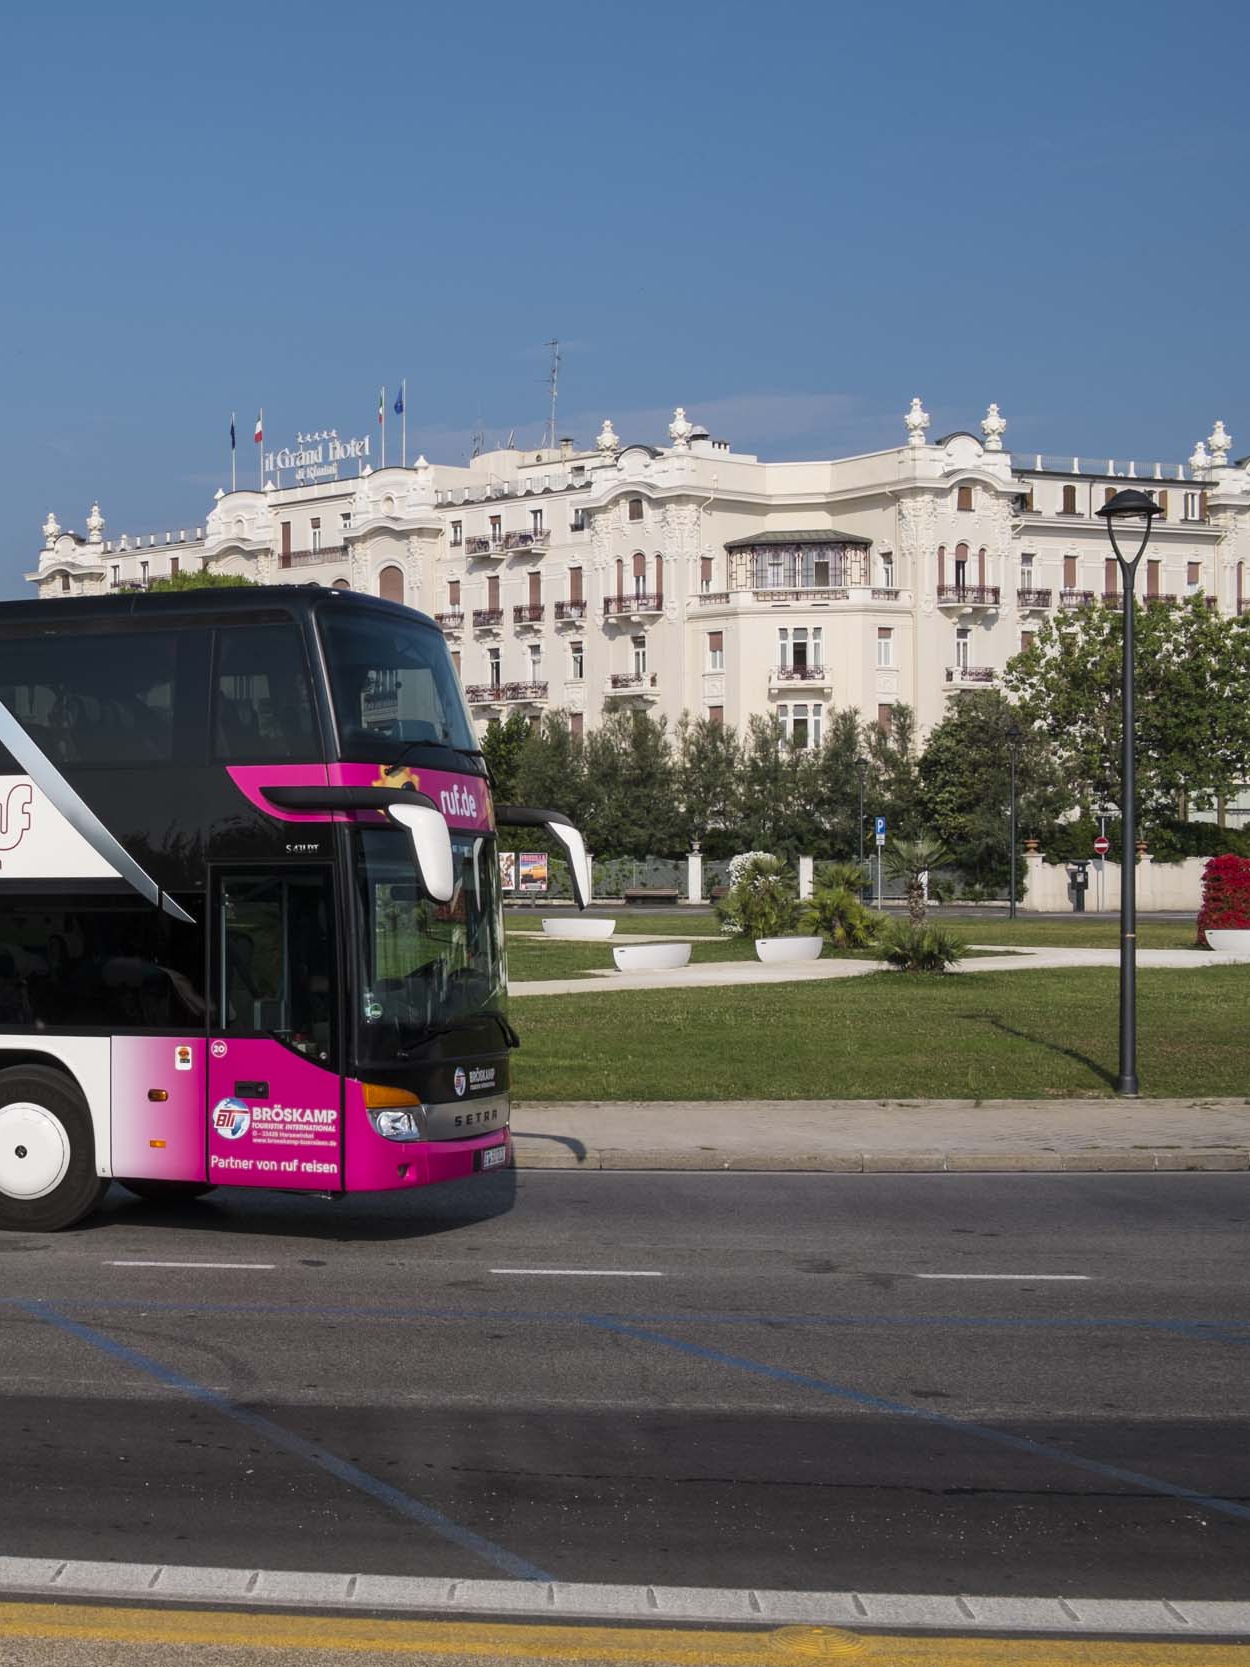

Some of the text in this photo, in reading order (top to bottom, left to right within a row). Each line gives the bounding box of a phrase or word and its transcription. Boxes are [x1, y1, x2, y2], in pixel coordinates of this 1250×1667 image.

[276, 444, 323, 469] Grand
[329, 434, 370, 461] Hotel
[440, 784, 477, 818] ruf.de
[252, 1104, 338, 1123] BRÖSKAMP
[454, 1109, 498, 1127] SETRA
[210, 1155, 338, 1174] Partner von ruf reisen
